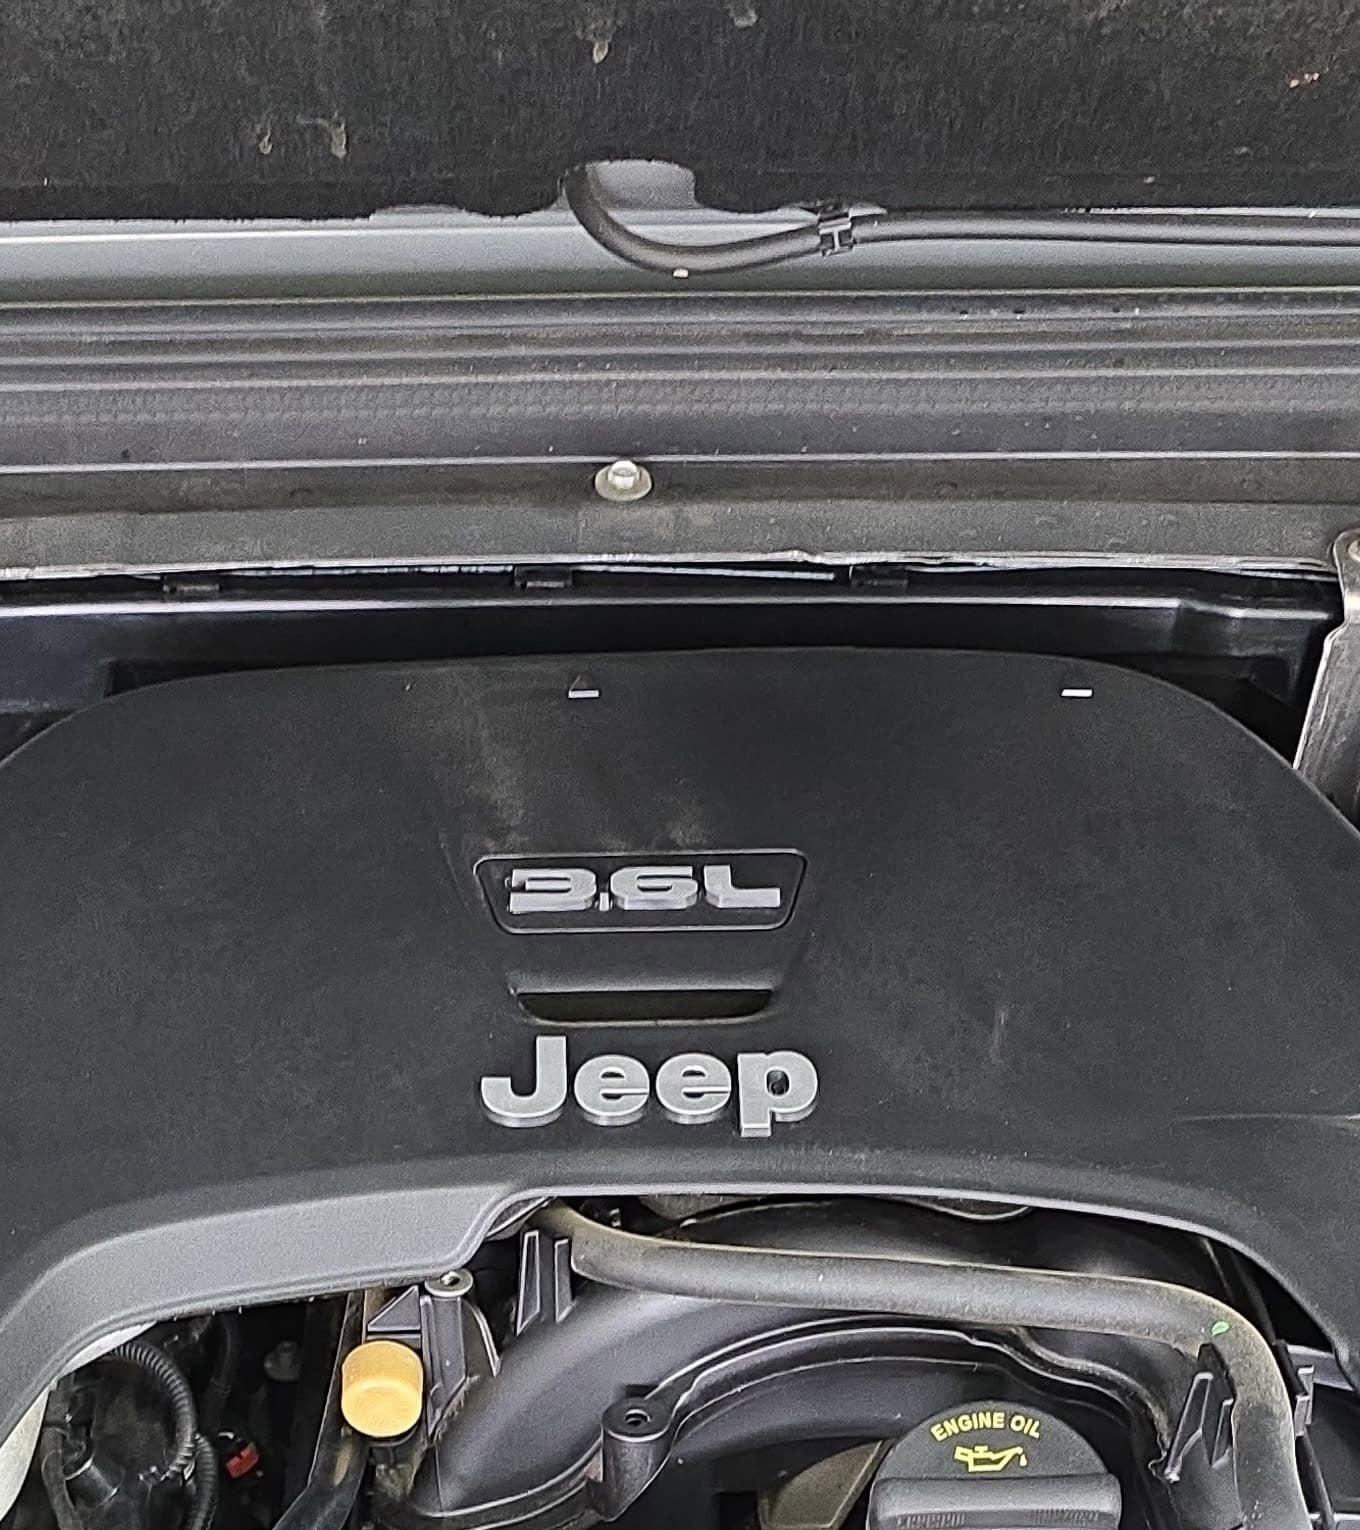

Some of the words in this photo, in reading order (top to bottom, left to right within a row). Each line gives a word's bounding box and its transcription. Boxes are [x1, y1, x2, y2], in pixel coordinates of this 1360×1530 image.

[506, 864, 781, 914] 3.6L
[481, 1035, 819, 1138] Jeep
[930, 1411, 1006, 1442] ENGINE
[1010, 1413, 1041, 1440] OIL
